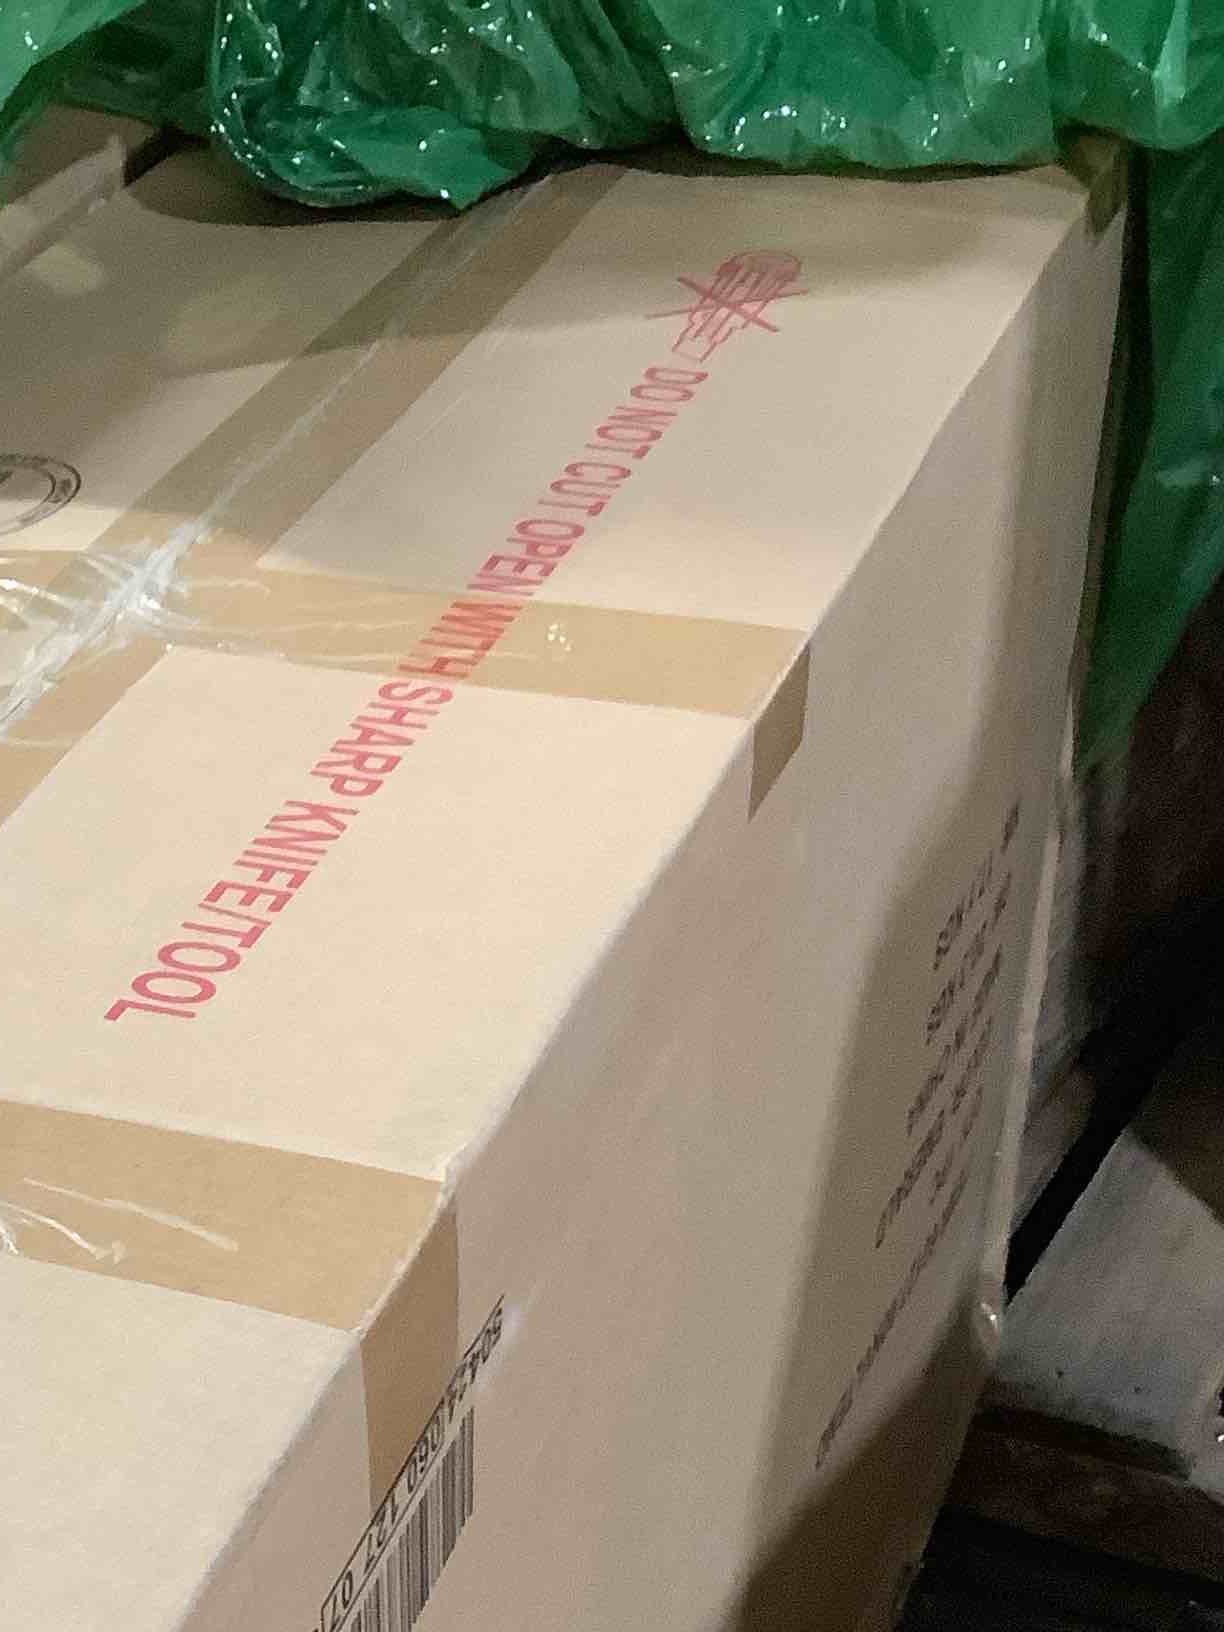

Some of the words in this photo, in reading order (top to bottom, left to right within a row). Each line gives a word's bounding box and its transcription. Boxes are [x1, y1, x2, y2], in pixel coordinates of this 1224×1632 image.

[629, 366, 709, 402] DO
[583, 405, 678, 460] NOT
[539, 461, 633, 517] CUT
[467, 518, 586, 597] OPEN
[397, 600, 520, 681] WITH
[309, 681, 455, 798] SHARP
[103, 799, 360, 1023] KNIFE/TOOL
